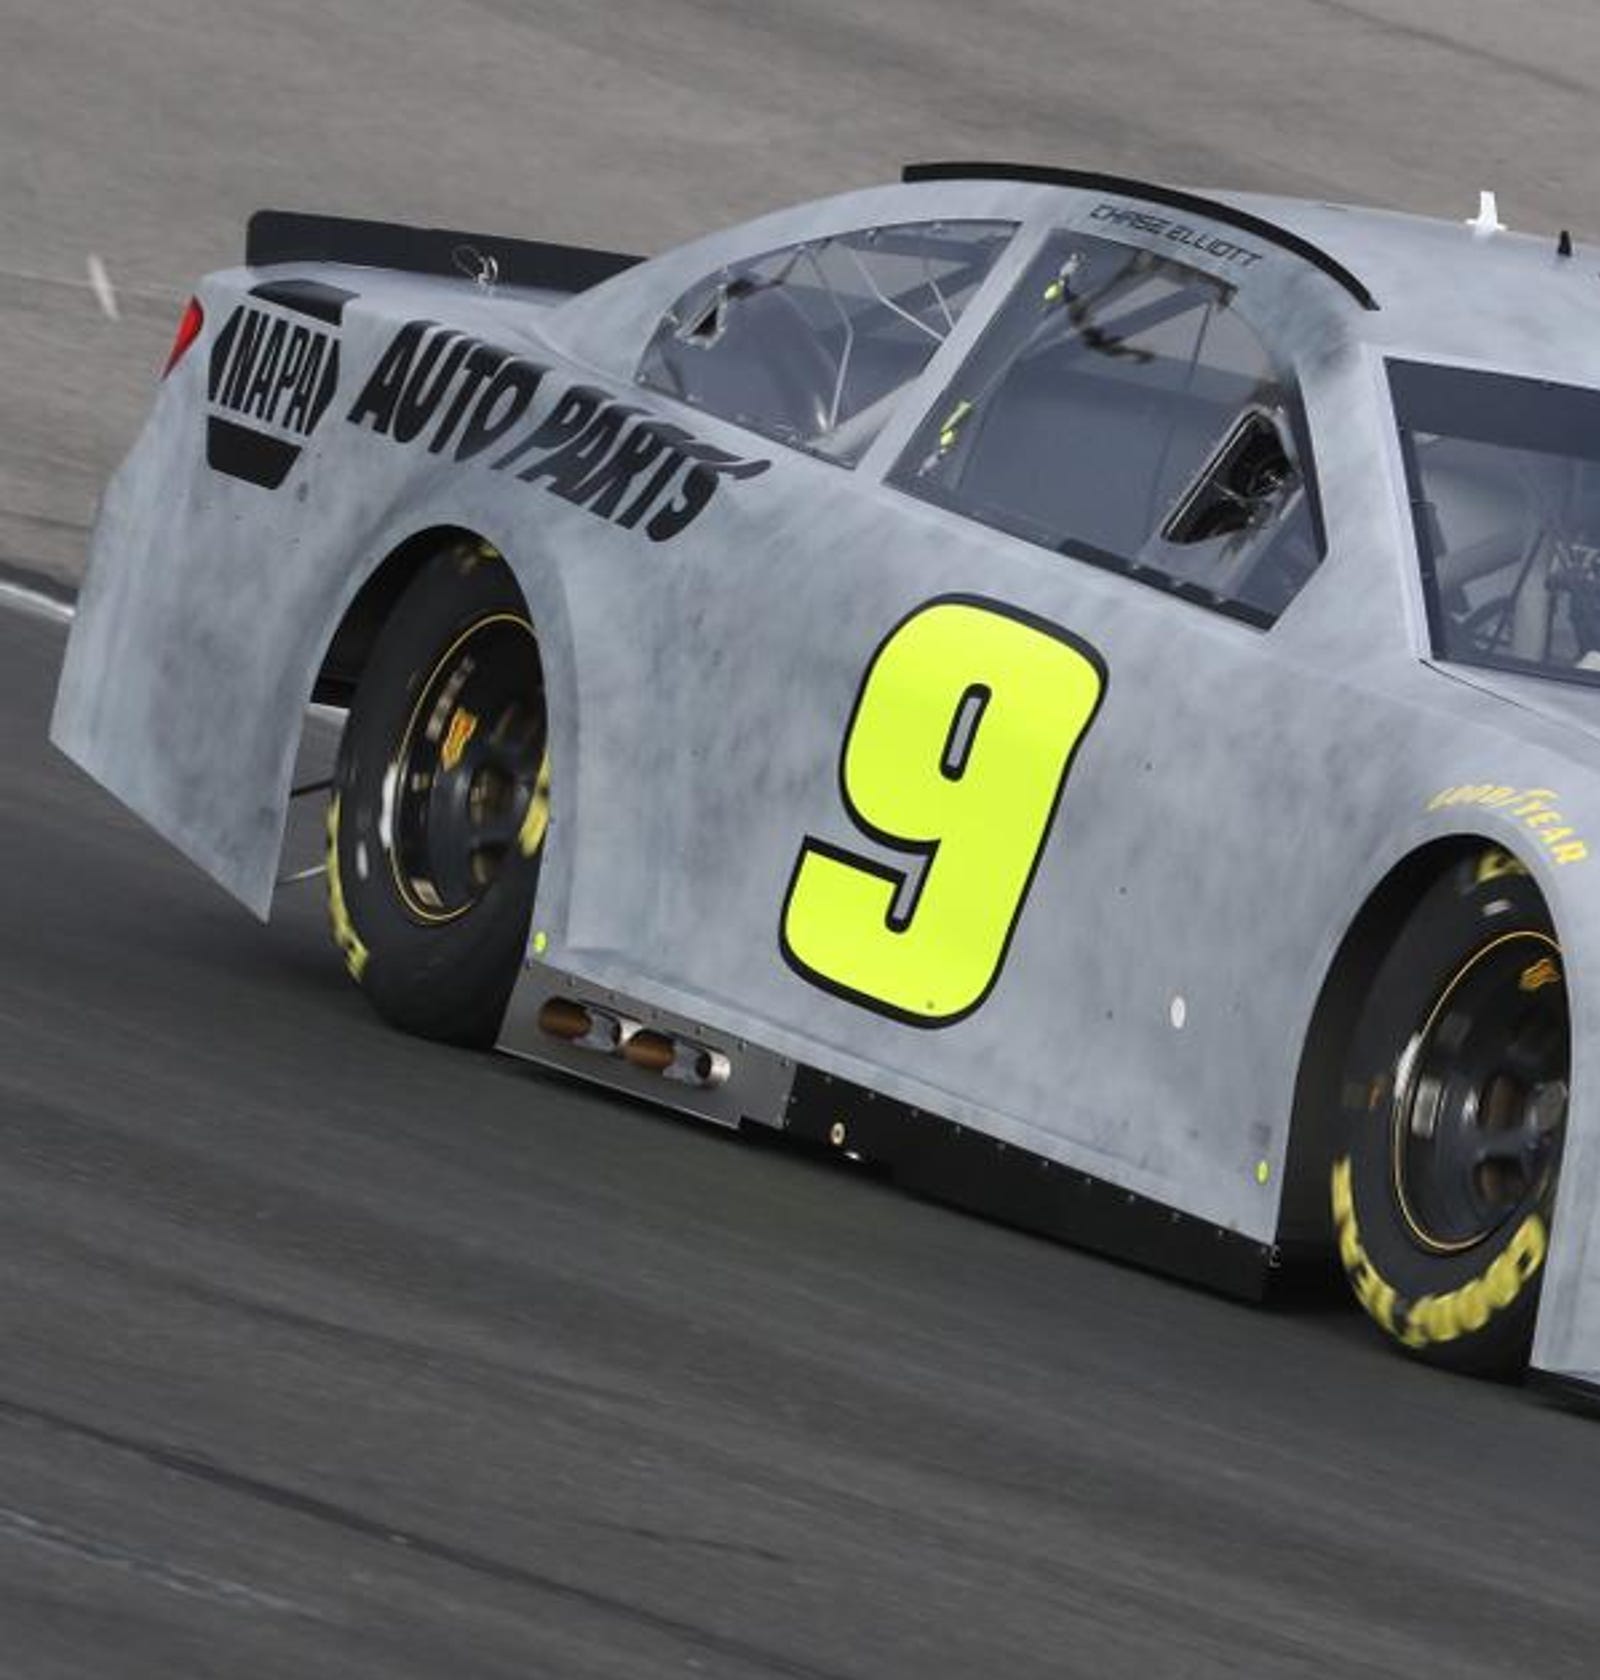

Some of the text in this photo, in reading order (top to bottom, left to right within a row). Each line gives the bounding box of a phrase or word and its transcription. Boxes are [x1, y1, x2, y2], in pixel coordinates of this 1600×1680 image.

[1089, 203, 1263, 267] CHASE ELLIOTT
[219, 308, 330, 435] NAPA
[346, 319, 772, 542] AUTO PARTS
[777, 592, 1110, 1030] 9
